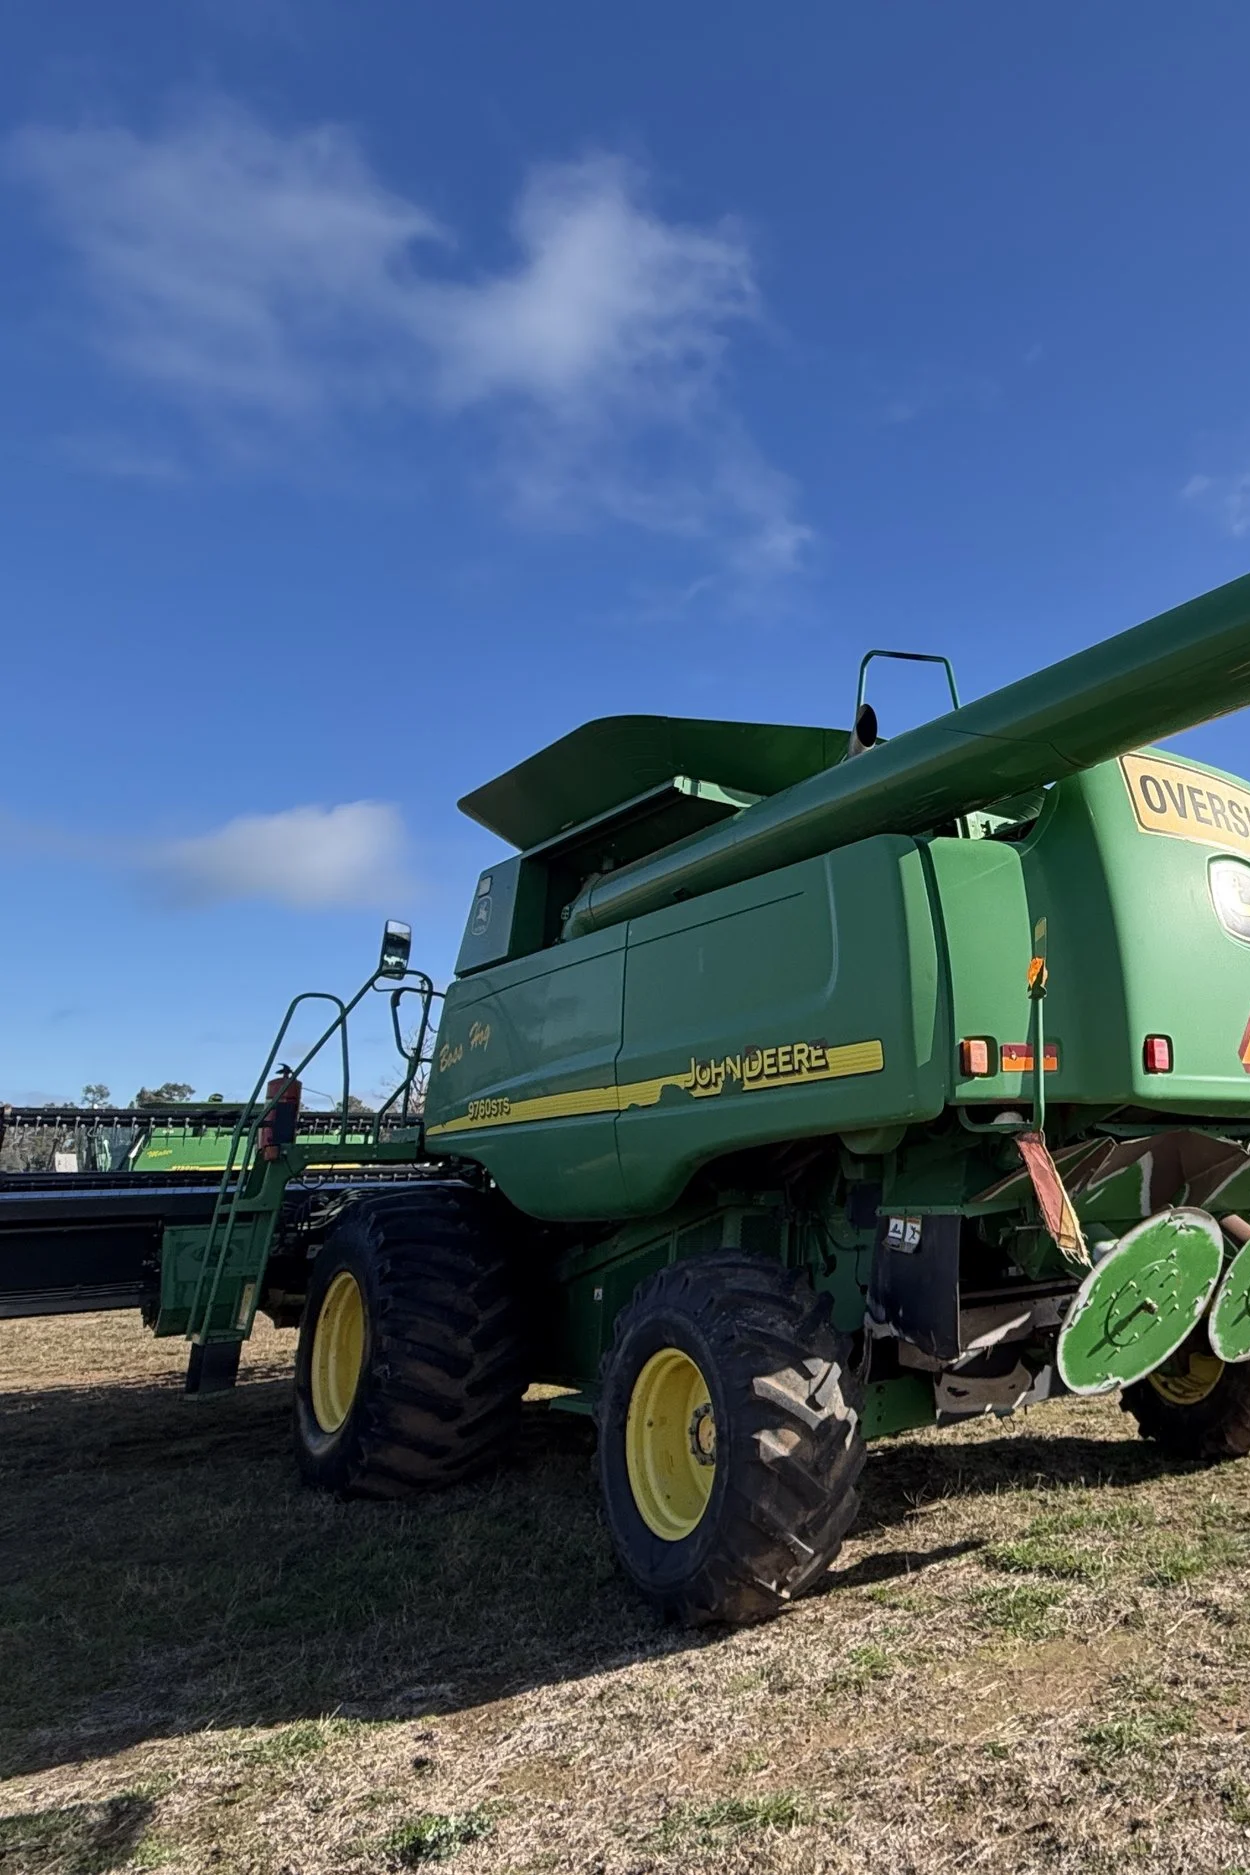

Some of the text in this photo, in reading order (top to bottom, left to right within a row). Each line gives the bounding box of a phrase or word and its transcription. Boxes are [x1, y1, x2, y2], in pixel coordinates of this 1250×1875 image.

[469, 1021, 490, 1052] Hog
[684, 1043, 829, 1089] JOHN DEERE
[468, 1097, 511, 1121] 9760STS
